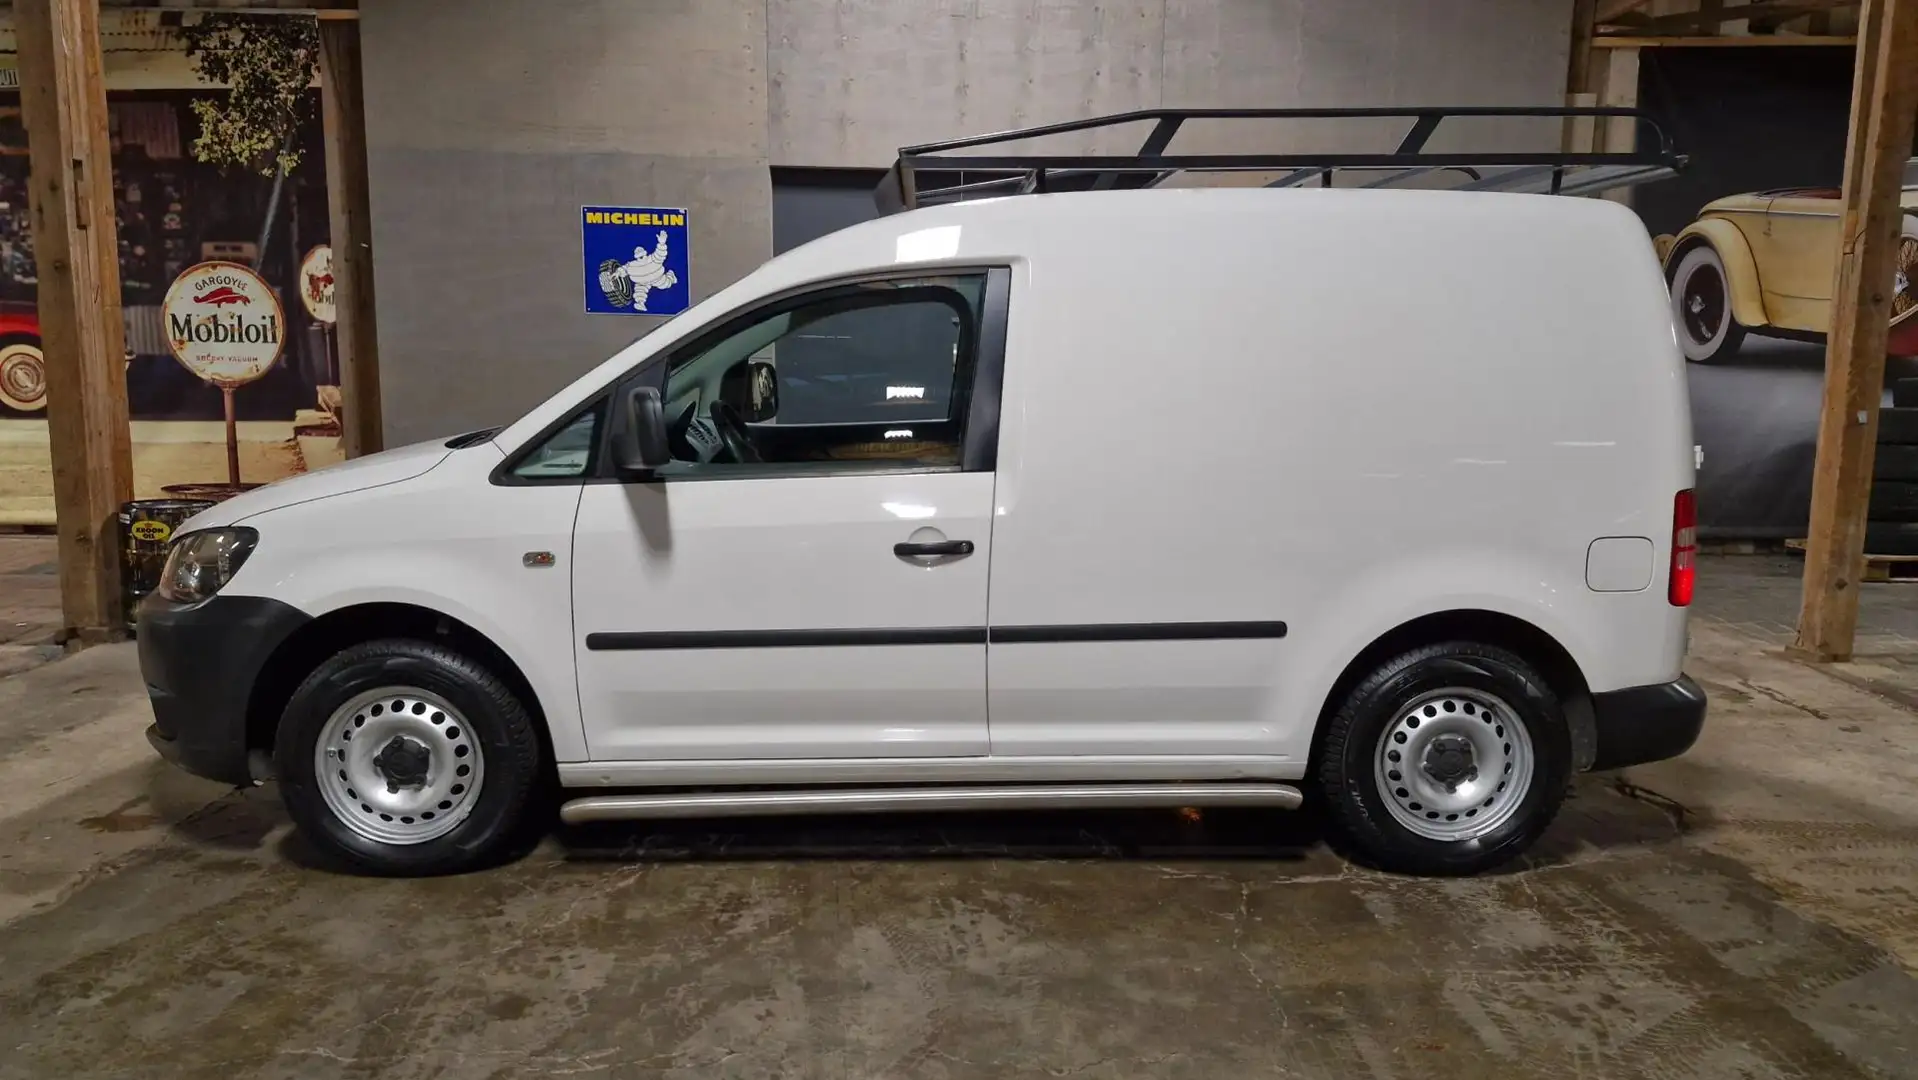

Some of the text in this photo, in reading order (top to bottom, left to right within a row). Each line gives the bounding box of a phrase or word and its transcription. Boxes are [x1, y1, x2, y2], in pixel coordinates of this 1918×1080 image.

[585, 212, 684, 226] MICHELIN
[194, 276, 248, 292] GARGOYLE
[169, 313, 278, 344] Mobiloil
